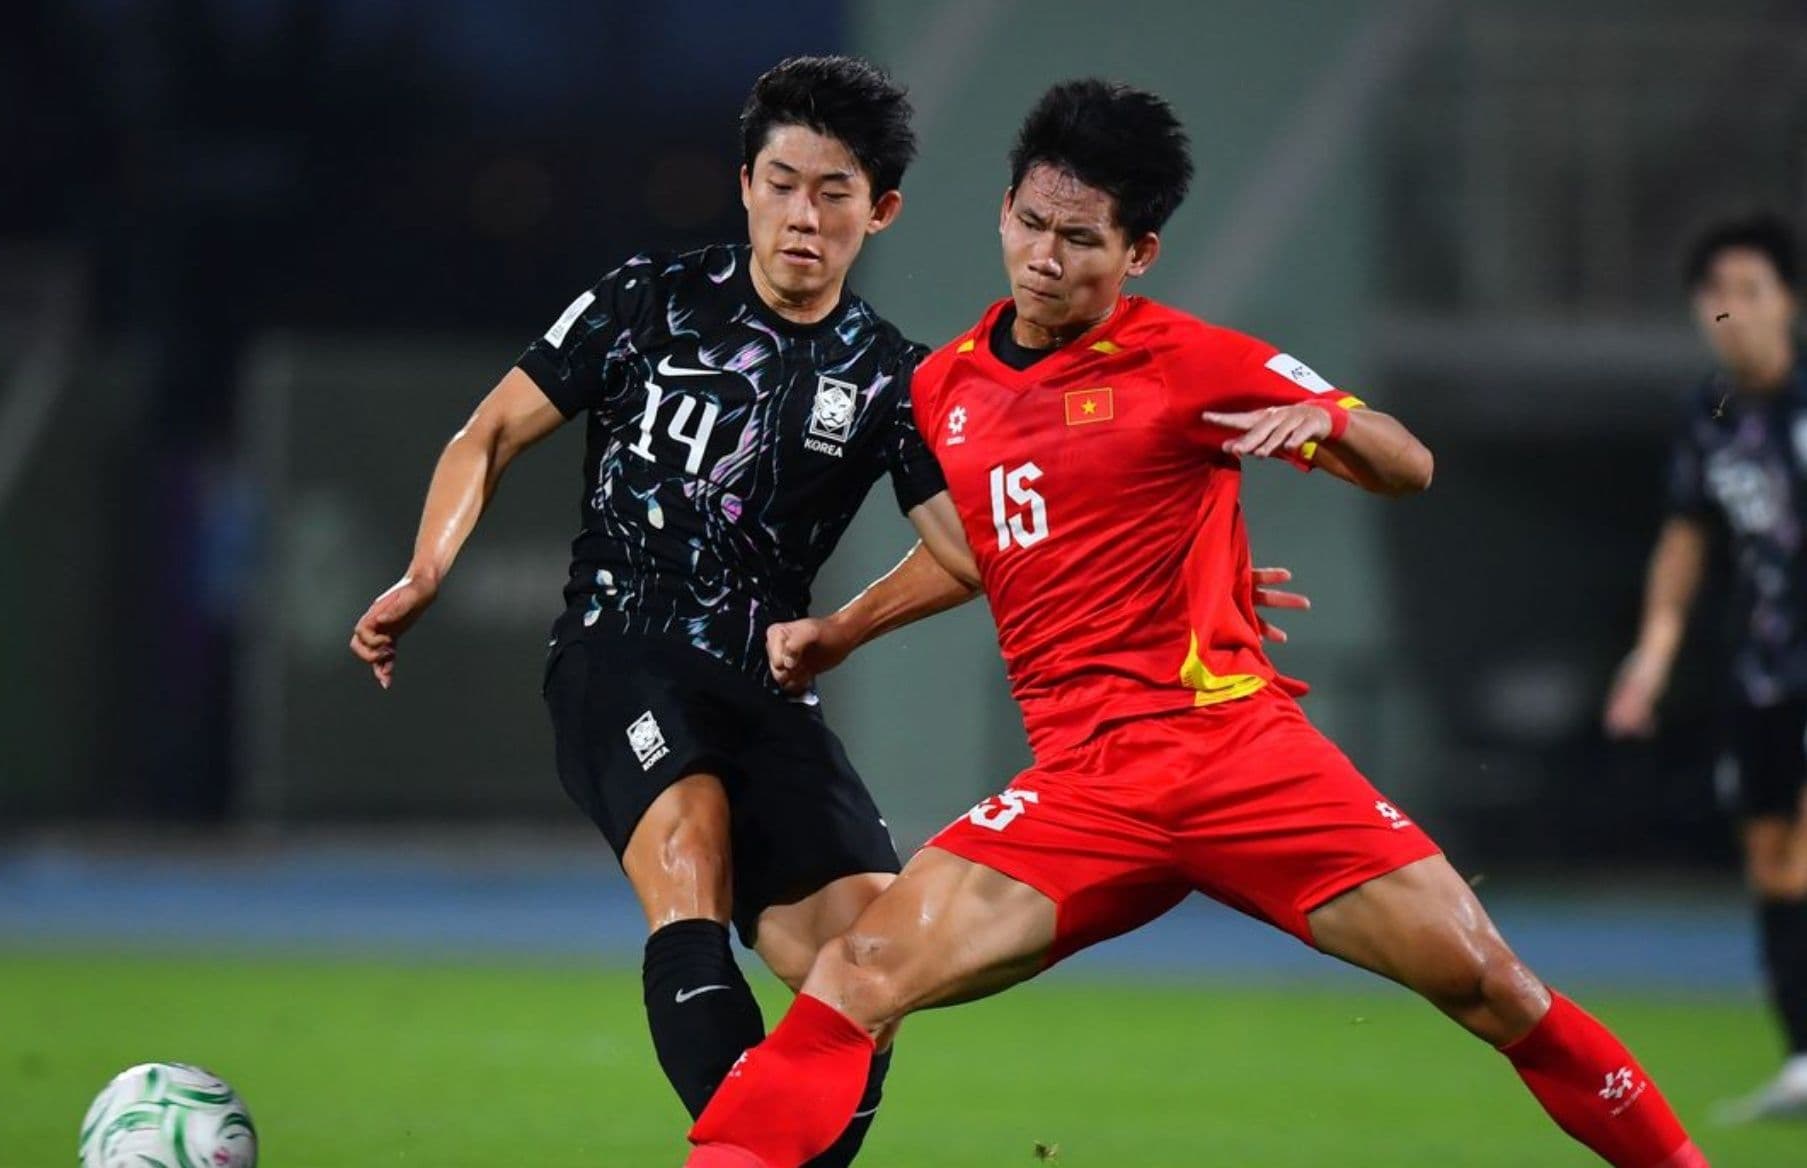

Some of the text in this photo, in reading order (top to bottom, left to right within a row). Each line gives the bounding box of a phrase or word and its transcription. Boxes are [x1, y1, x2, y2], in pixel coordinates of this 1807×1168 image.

[629, 381, 720, 475] 14
[804, 438, 843, 458] KOREA
[990, 461, 1049, 552] 15
[642, 746, 670, 771] KOREA
